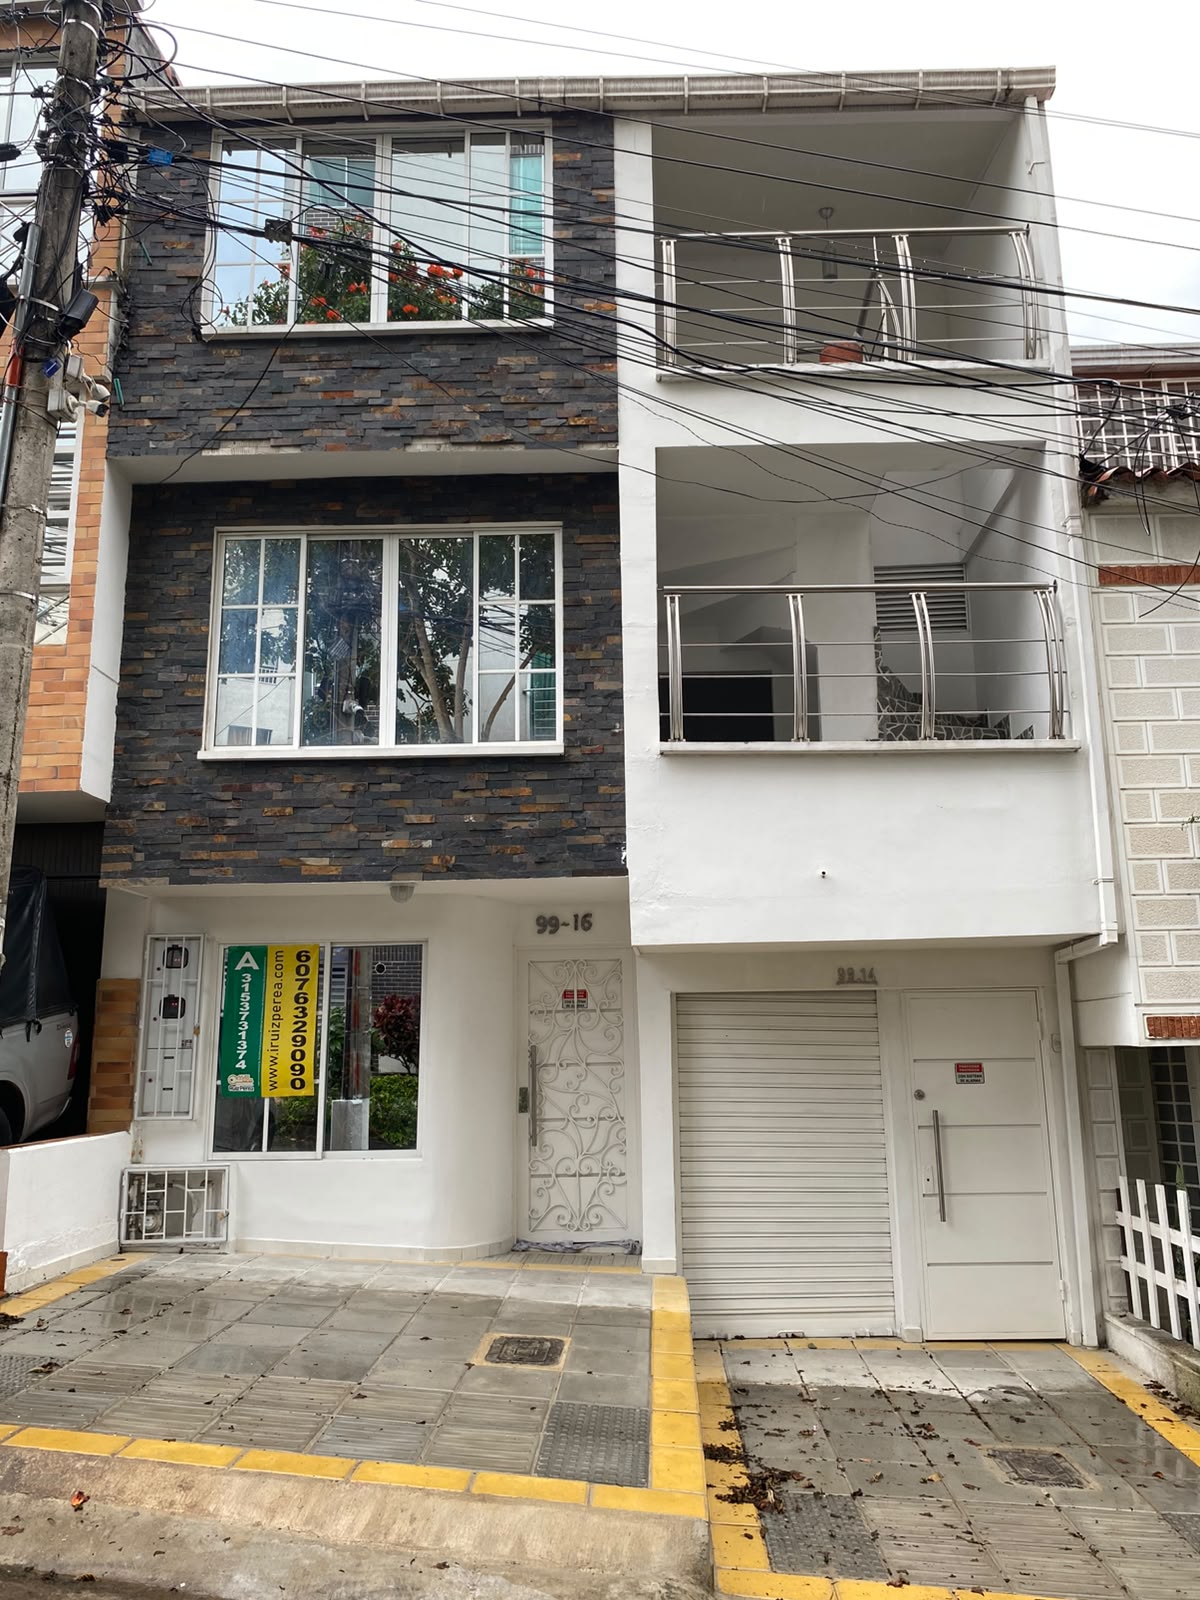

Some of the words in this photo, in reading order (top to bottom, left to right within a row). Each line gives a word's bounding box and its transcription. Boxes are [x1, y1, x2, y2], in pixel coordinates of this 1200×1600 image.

[234, 951, 260, 971] A
[289, 949, 311, 1090] 6076329090
[235, 973, 252, 1070] 3153731374
[267, 950, 284, 1092] www.iruizperea.com
